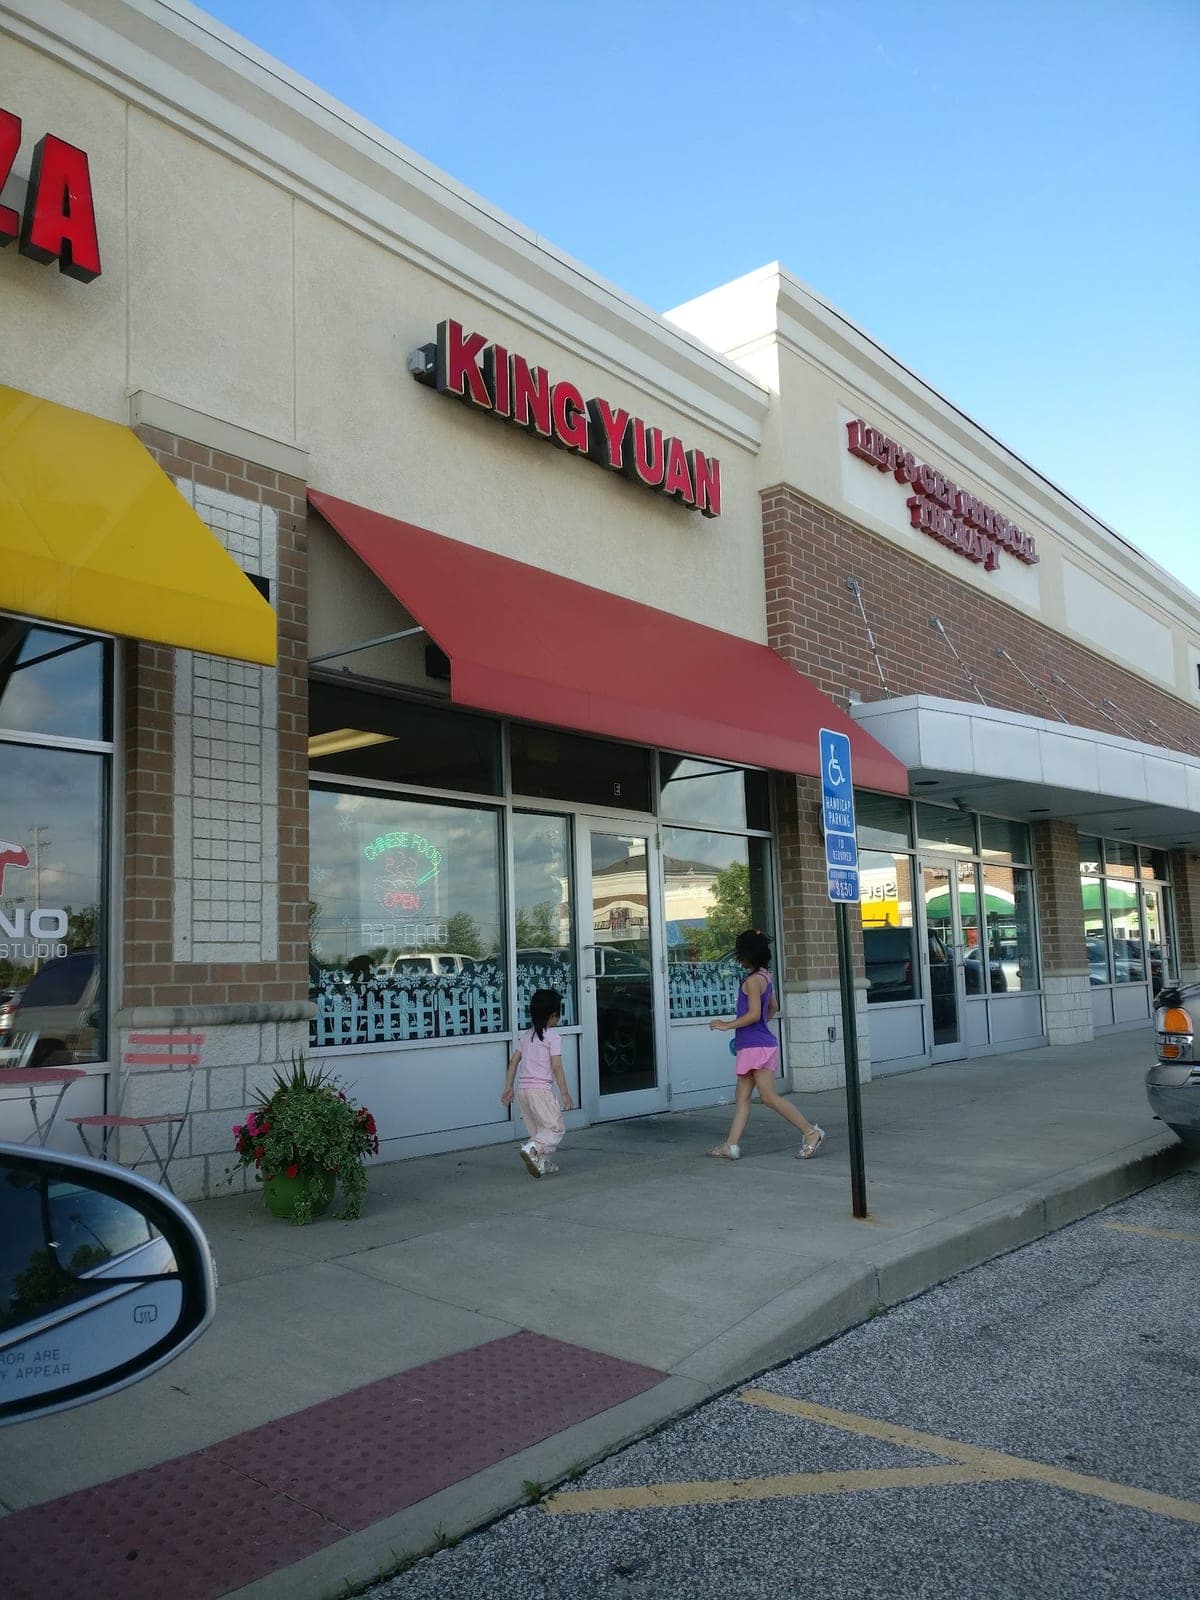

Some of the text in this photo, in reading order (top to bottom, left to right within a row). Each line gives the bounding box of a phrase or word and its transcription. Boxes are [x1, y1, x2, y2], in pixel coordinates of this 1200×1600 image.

[437, 318, 721, 518] KING YUAN
[846, 419, 917, 484] LET'S
[912, 464, 958, 511] GET
[907, 495, 1000, 571] THERAPY
[825, 796, 851, 813] HANDICAP
[828, 811, 851, 827] PARKING
[383, 892, 422, 911] OPEN
[0, 943, 68, 959] STUDIO
[33, 1349, 61, 1362] ARE
[16, 1363, 70, 1379] APPEAR
